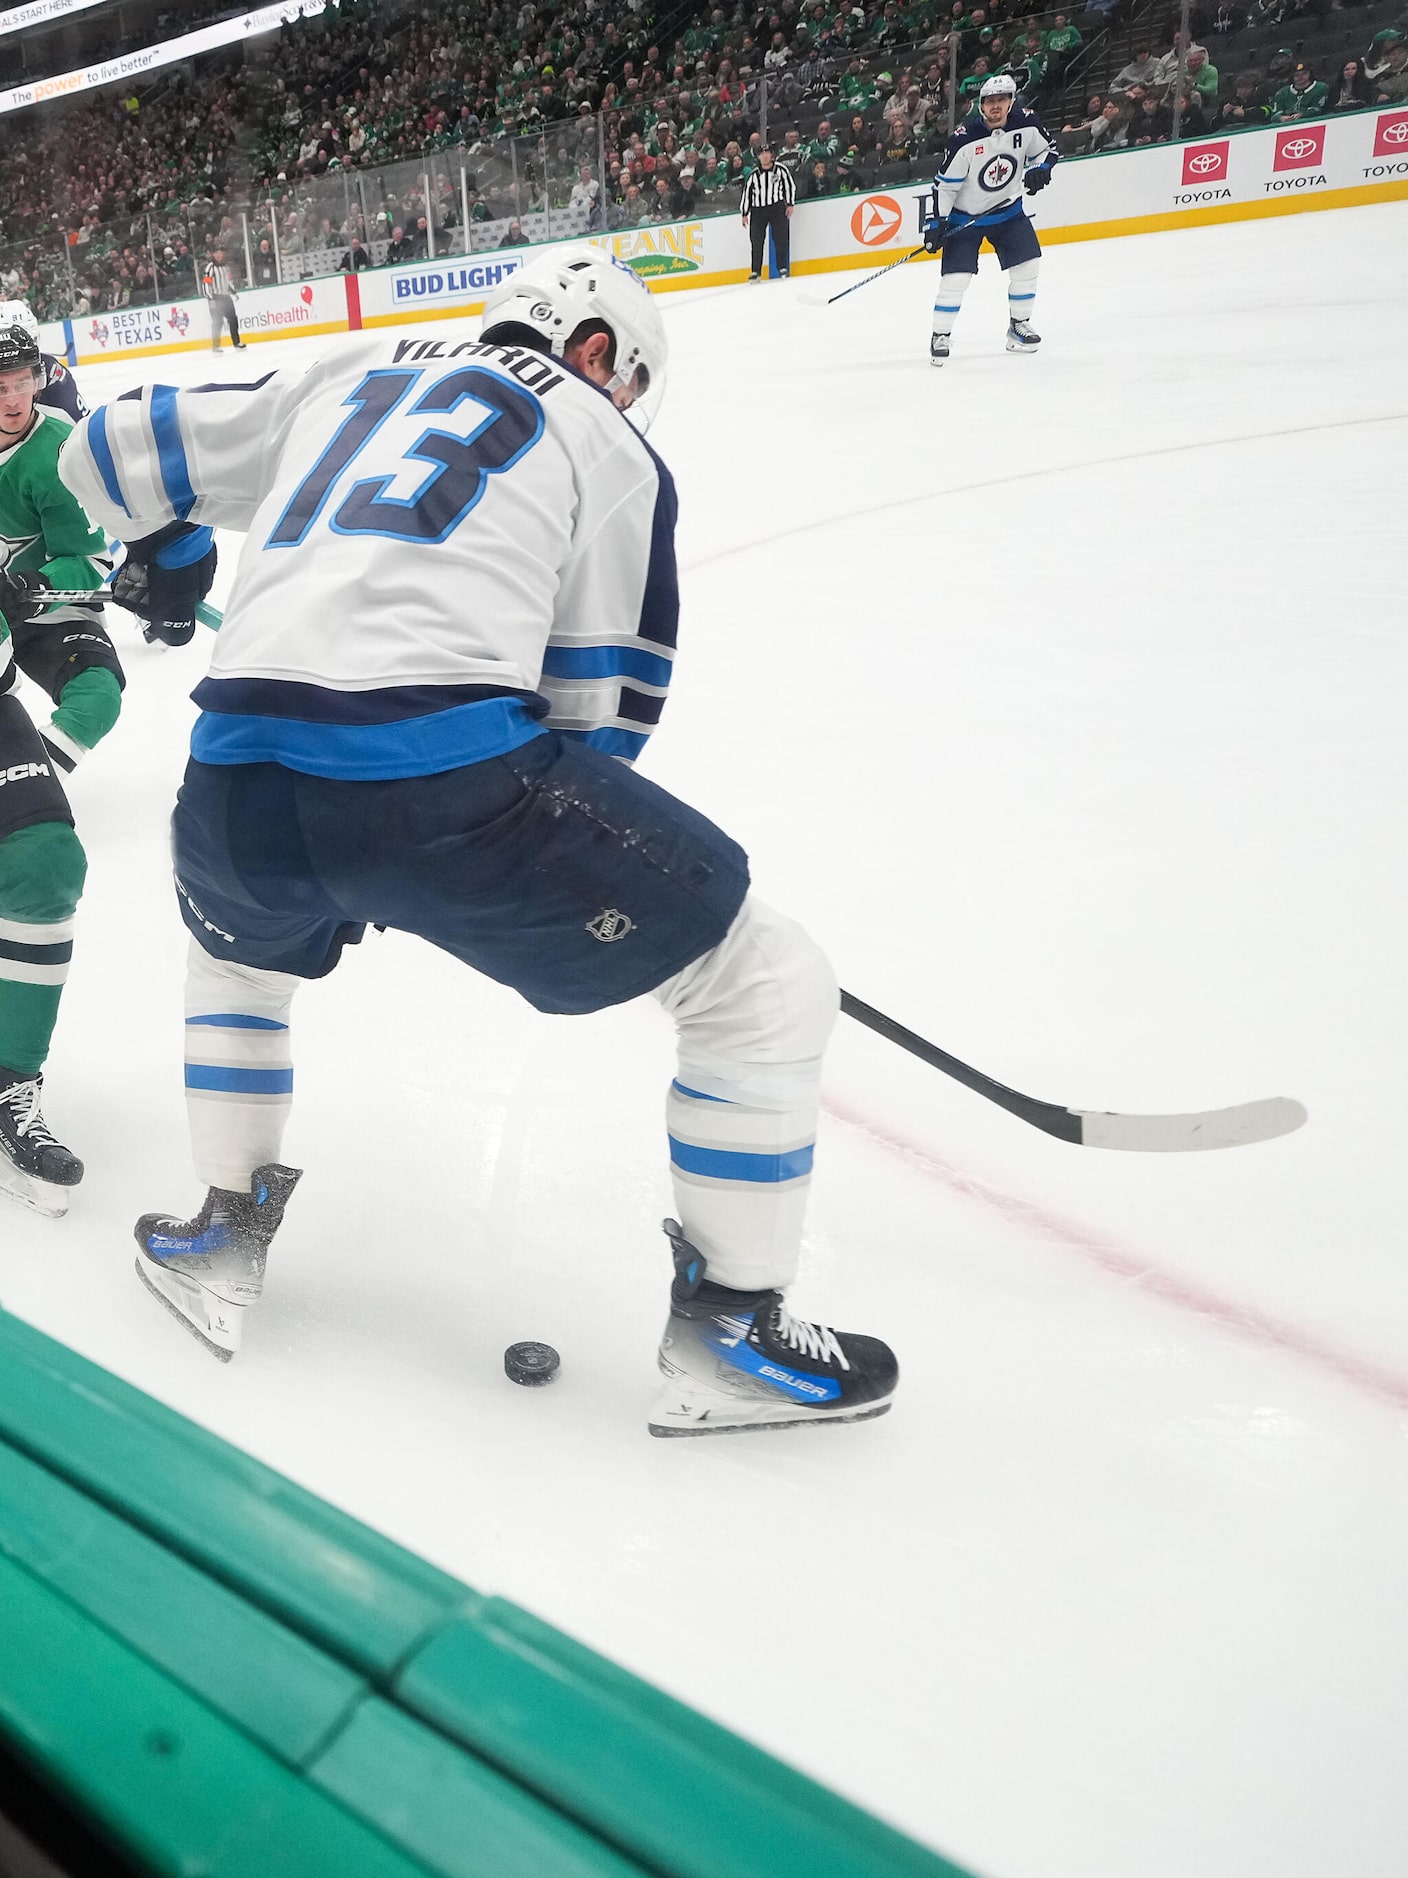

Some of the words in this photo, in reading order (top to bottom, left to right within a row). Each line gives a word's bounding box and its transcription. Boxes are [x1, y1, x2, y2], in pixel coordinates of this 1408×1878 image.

[20, 6, 49, 24] START
[12, 90, 32, 104] The
[34, 73, 84, 103] power
[87, 71, 99, 83] to
[100, 65, 119, 81] live
[1013, 133, 1022, 149] A
[1362, 161, 1408, 178] TOYO
[1264, 175, 1327, 192] TOYOTA
[1173, 188, 1232, 205] TOYOTA
[396, 273, 443, 298] BUD
[448, 263, 517, 291] LIGHT
[113, 312, 142, 329] BEST
[147, 309, 160, 323] IN
[116, 326, 162, 346] TEXAS
[392, 339, 566, 397] VILARDI
[264, 364, 545, 551] 13
[162, 620, 192, 629] CCM
[63, 633, 112, 648] CCM
[152, 1240, 193, 1251] BAUER
[758, 1365, 829, 1399] BAUER
